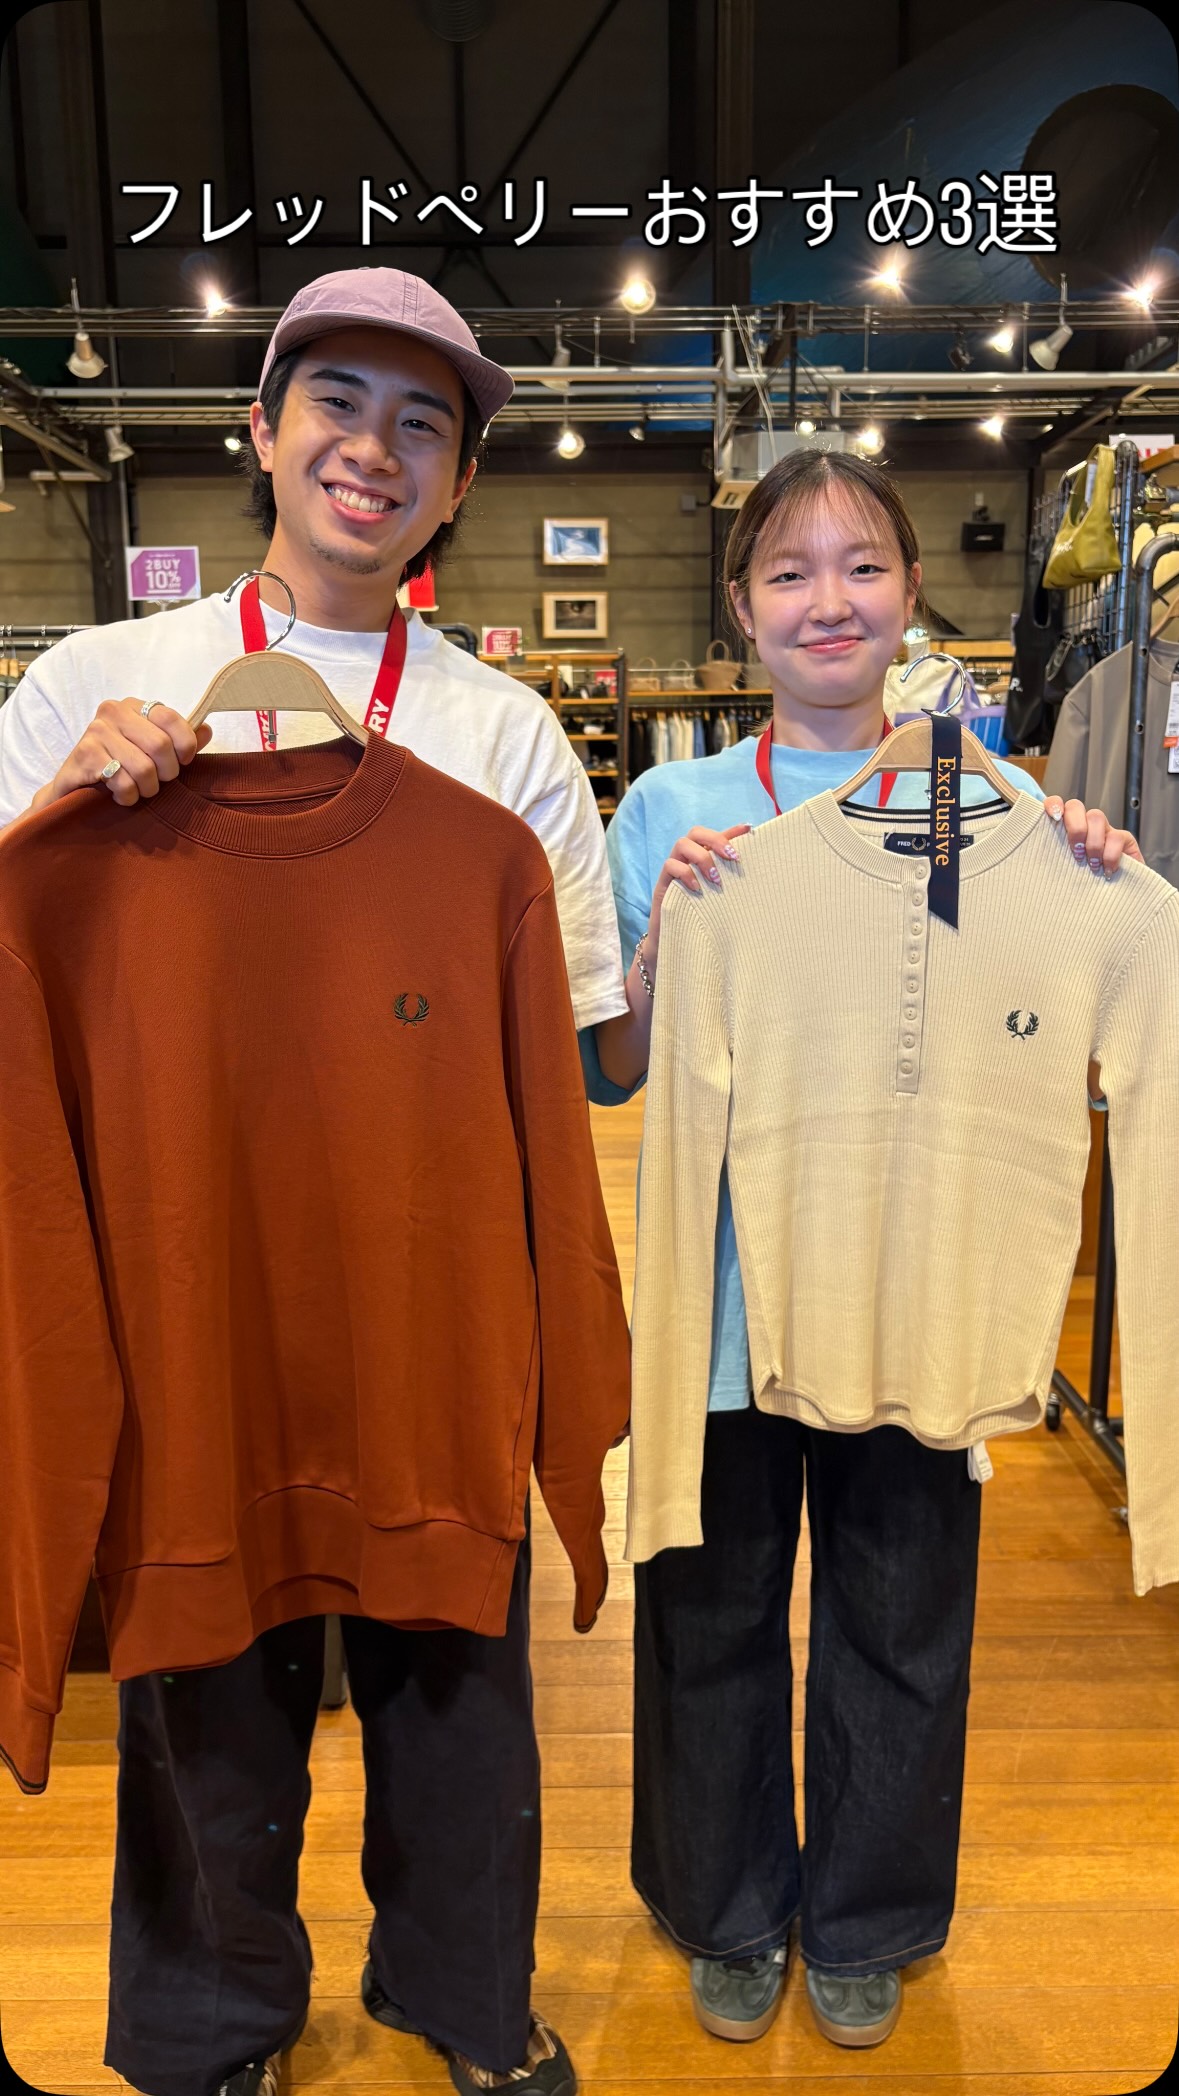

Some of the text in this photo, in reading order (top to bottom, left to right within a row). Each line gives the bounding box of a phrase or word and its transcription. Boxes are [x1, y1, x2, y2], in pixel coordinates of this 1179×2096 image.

[145, 559, 180, 570] 2BUY
[146, 570, 181, 590] 10%
[935, 756, 957, 866] Exclusive
